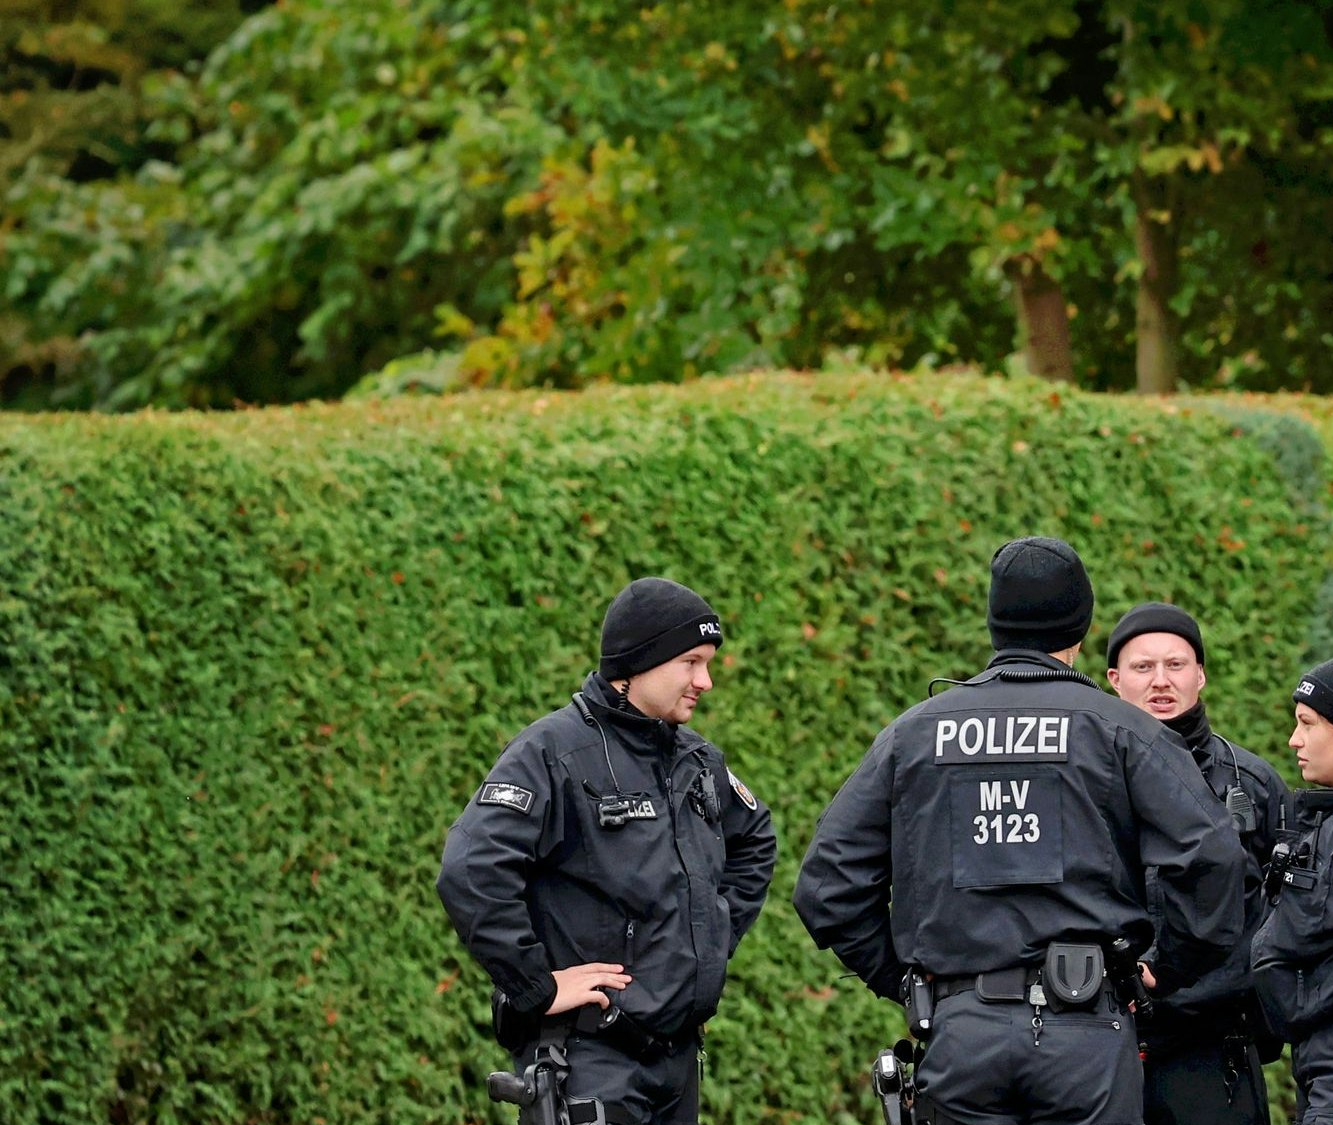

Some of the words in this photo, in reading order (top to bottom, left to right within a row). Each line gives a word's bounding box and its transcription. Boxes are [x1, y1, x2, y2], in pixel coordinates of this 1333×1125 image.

[936, 717, 1069, 756] POLIZEI
[980, 780, 1030, 811] M-V
[973, 813, 1040, 844] 3123
